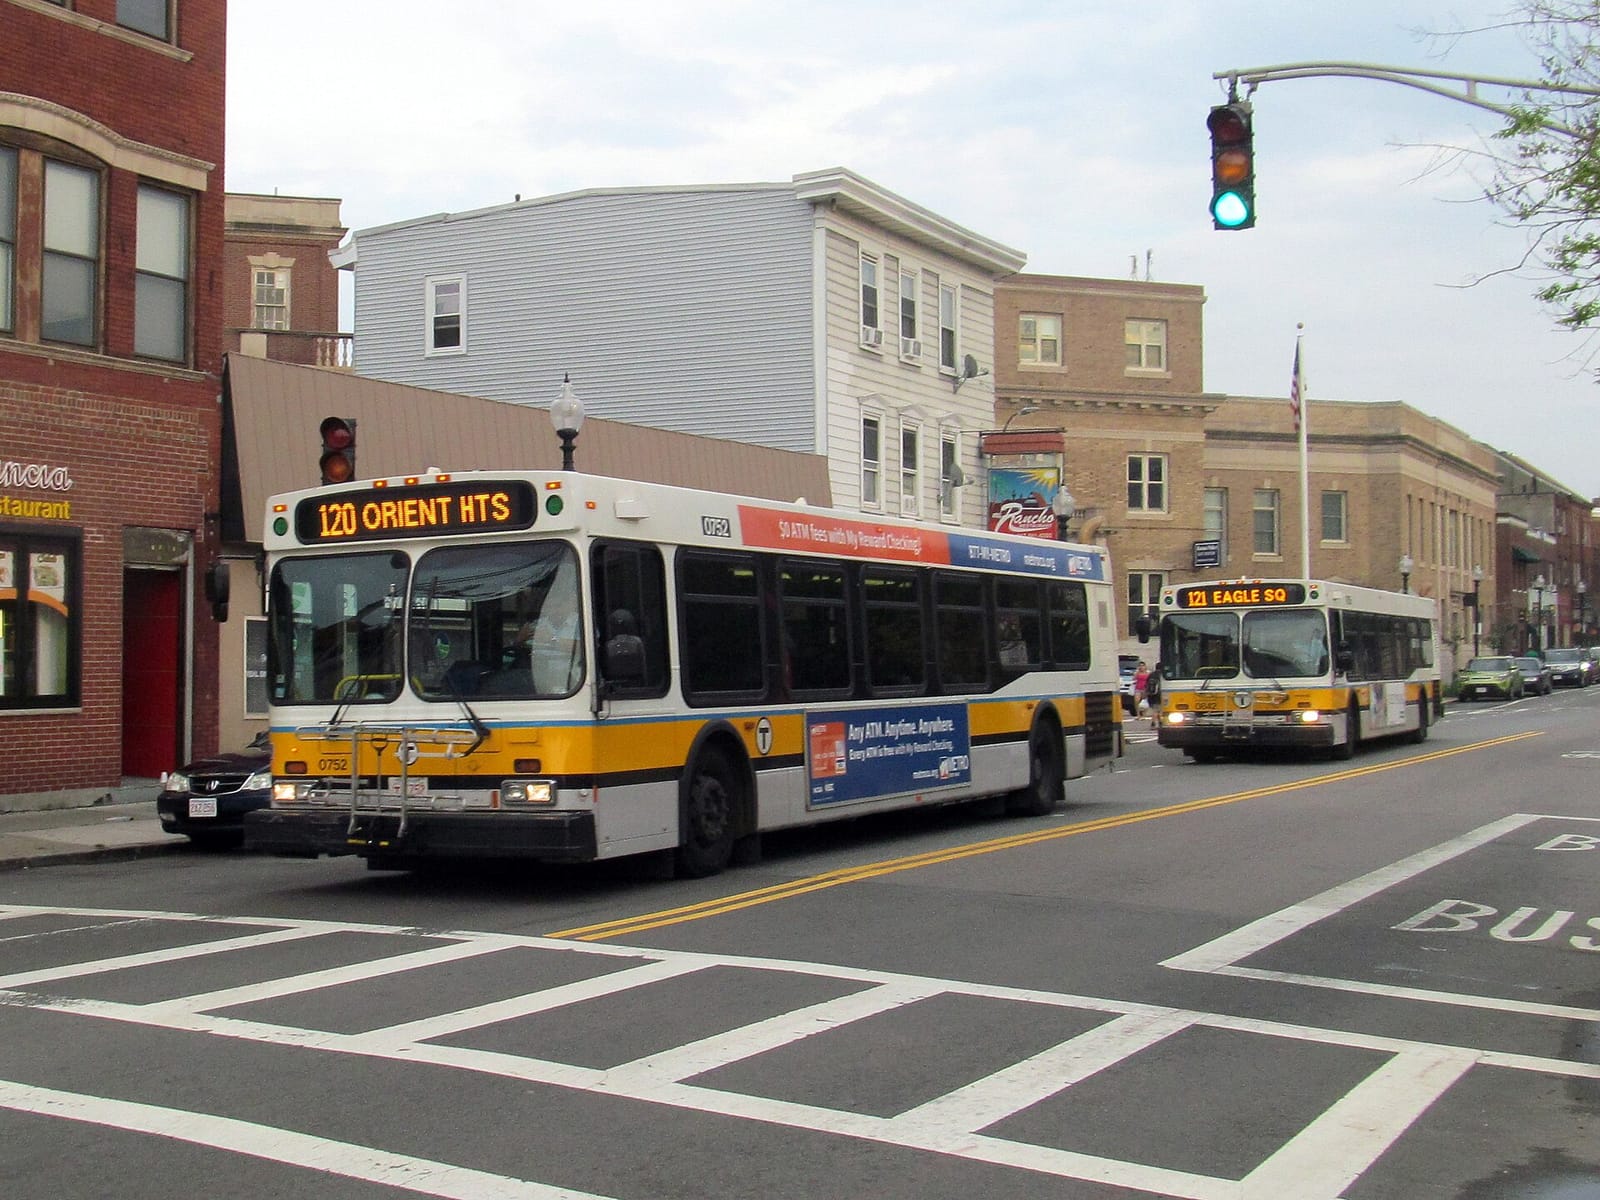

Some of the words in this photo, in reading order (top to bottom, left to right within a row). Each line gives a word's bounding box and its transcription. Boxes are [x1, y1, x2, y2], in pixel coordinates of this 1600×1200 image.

[319, 503, 357, 537] 120
[362, 497, 452, 529] ORIENT
[459, 492, 511, 523] HTS
[992, 502, 1055, 533] Rancho
[703, 518, 729, 536] 0752
[791, 522, 810, 540] ATM
[810, 523, 829, 542] fees
[1188, 591, 1207, 606] 121
[1213, 589, 1260, 604] EAGLE
[1263, 588, 1286, 602] SQ
[848, 724, 865, 744] Any
[319, 758, 347, 771] 0752
